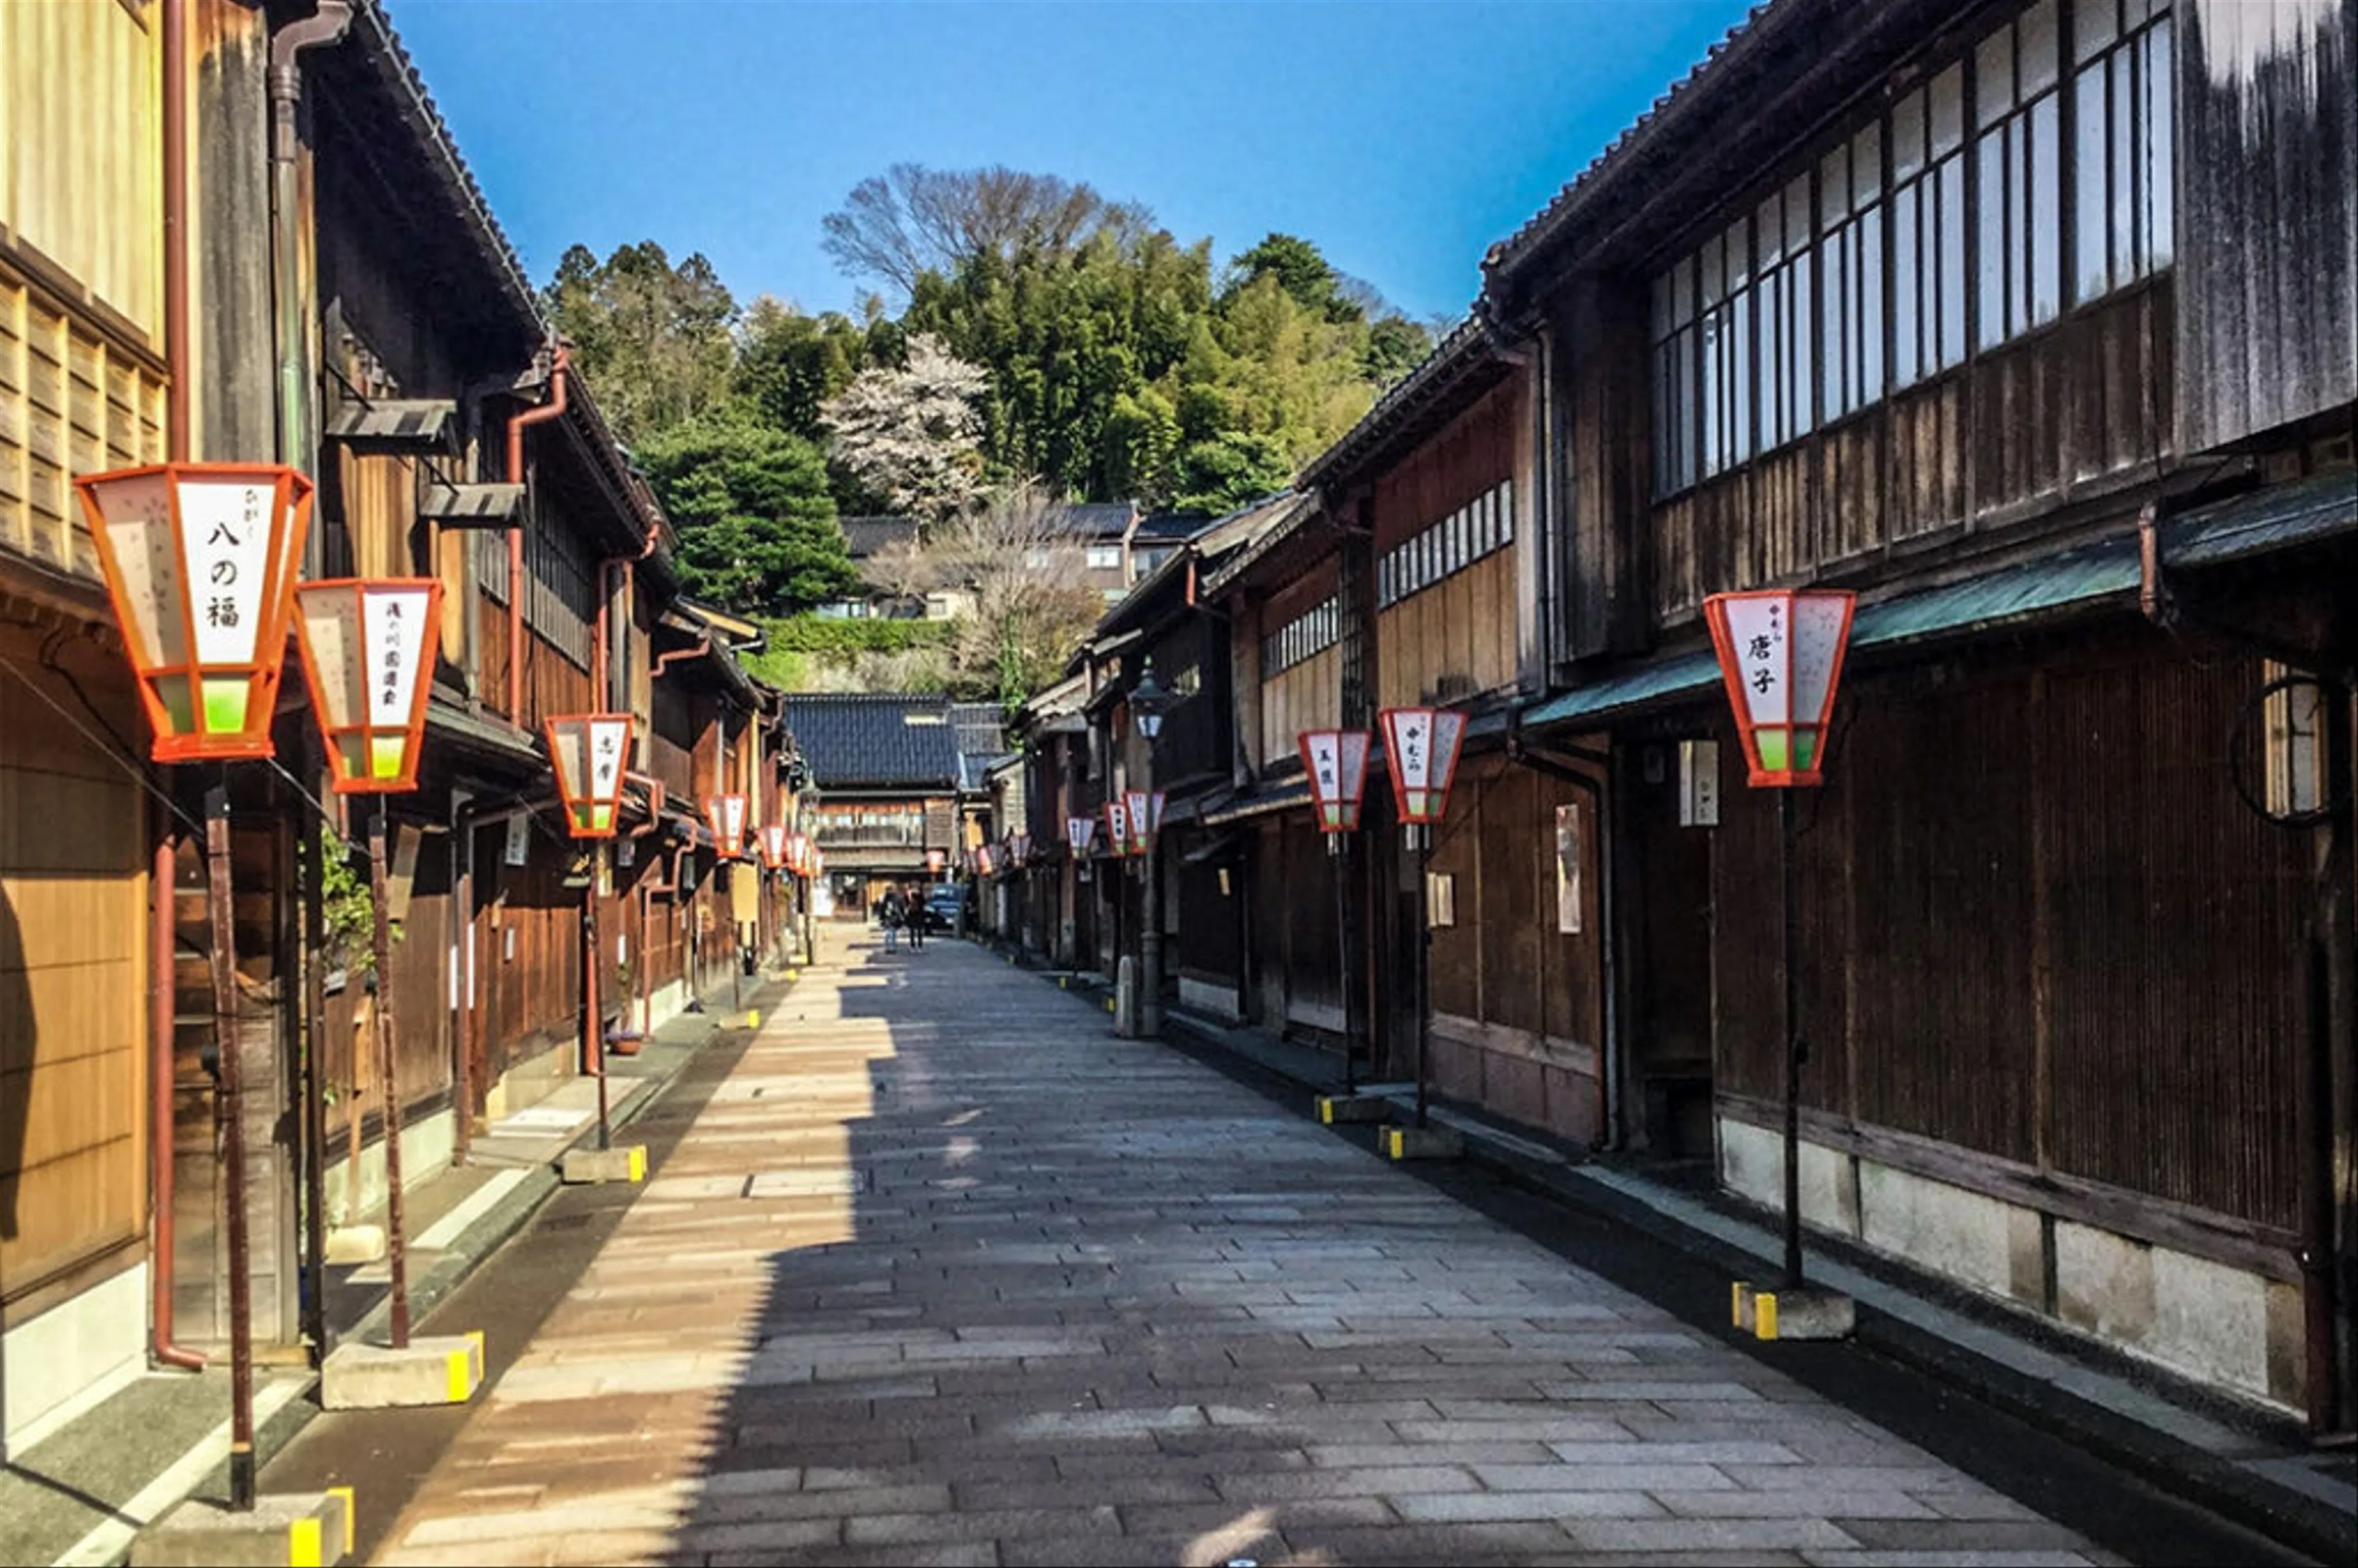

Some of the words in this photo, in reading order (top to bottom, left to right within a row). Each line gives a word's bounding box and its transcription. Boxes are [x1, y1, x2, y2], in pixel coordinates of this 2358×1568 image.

[207, 522, 239, 628] 八の福
[1748, 634, 1776, 694] 唐子
